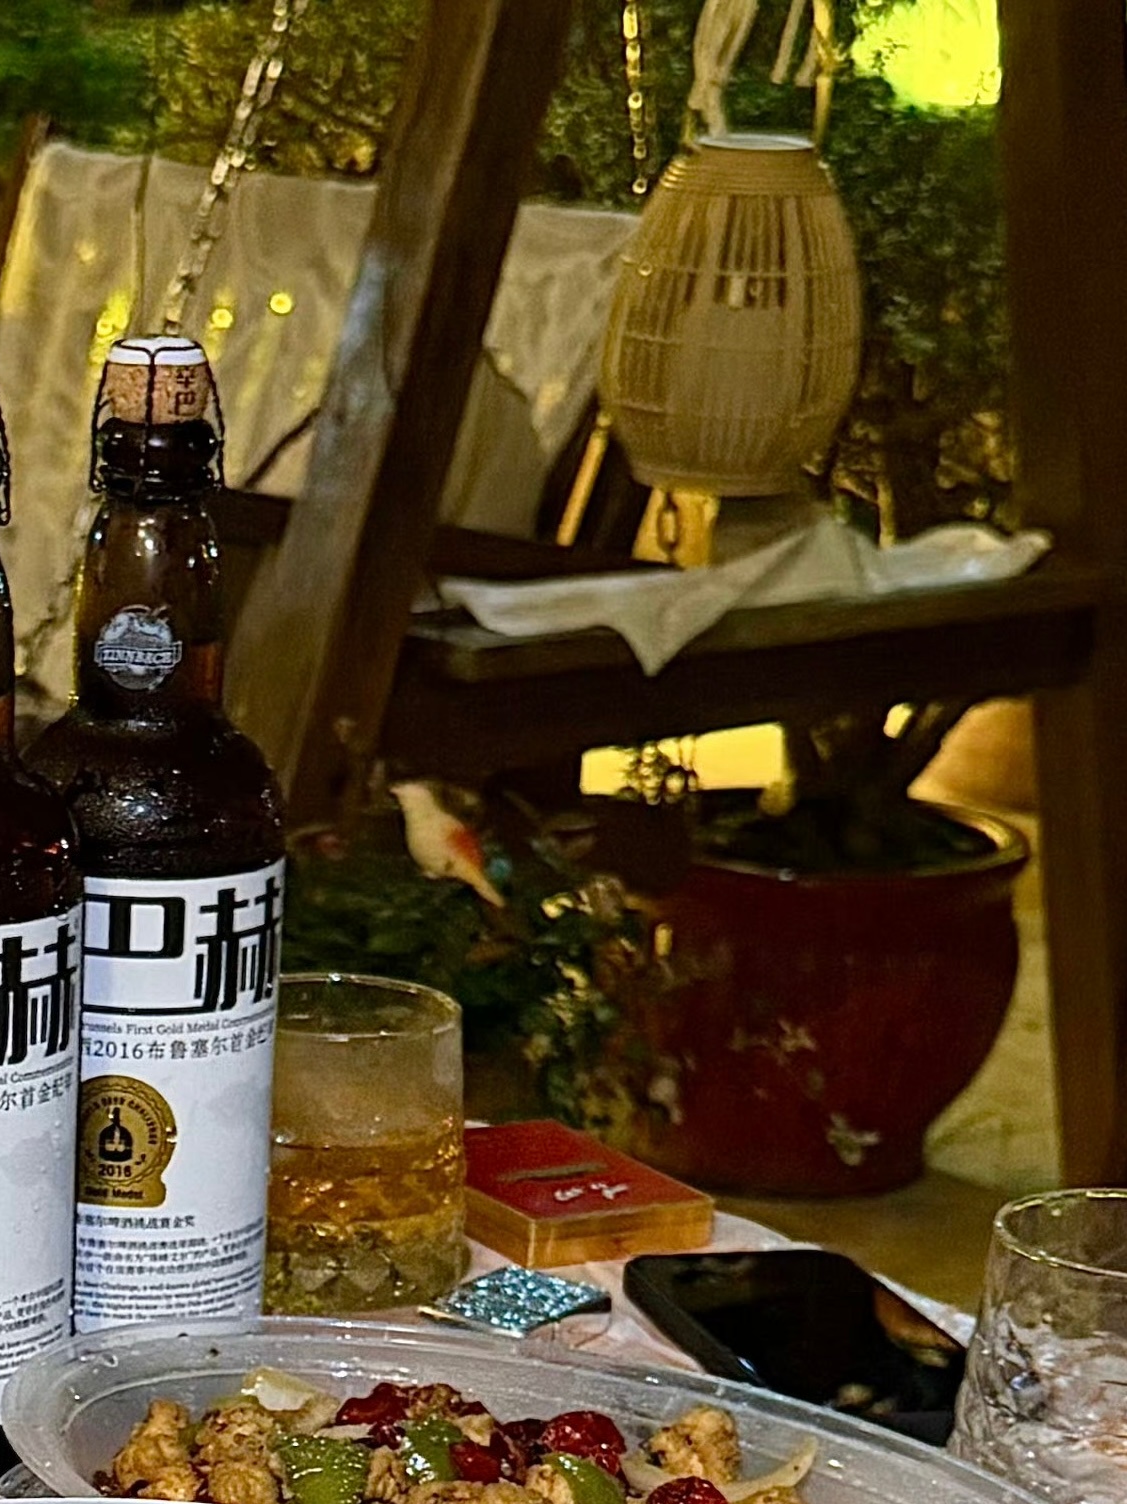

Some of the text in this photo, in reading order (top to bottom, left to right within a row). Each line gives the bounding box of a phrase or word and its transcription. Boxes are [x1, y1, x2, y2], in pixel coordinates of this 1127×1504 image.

[126, 1023, 153, 1035] First
[156, 1022, 184, 1035] Gold
[97, 1162, 133, 1179] 2016
[76, 1213, 195, 1230] 塞尔啤酒挑战赛金奖
